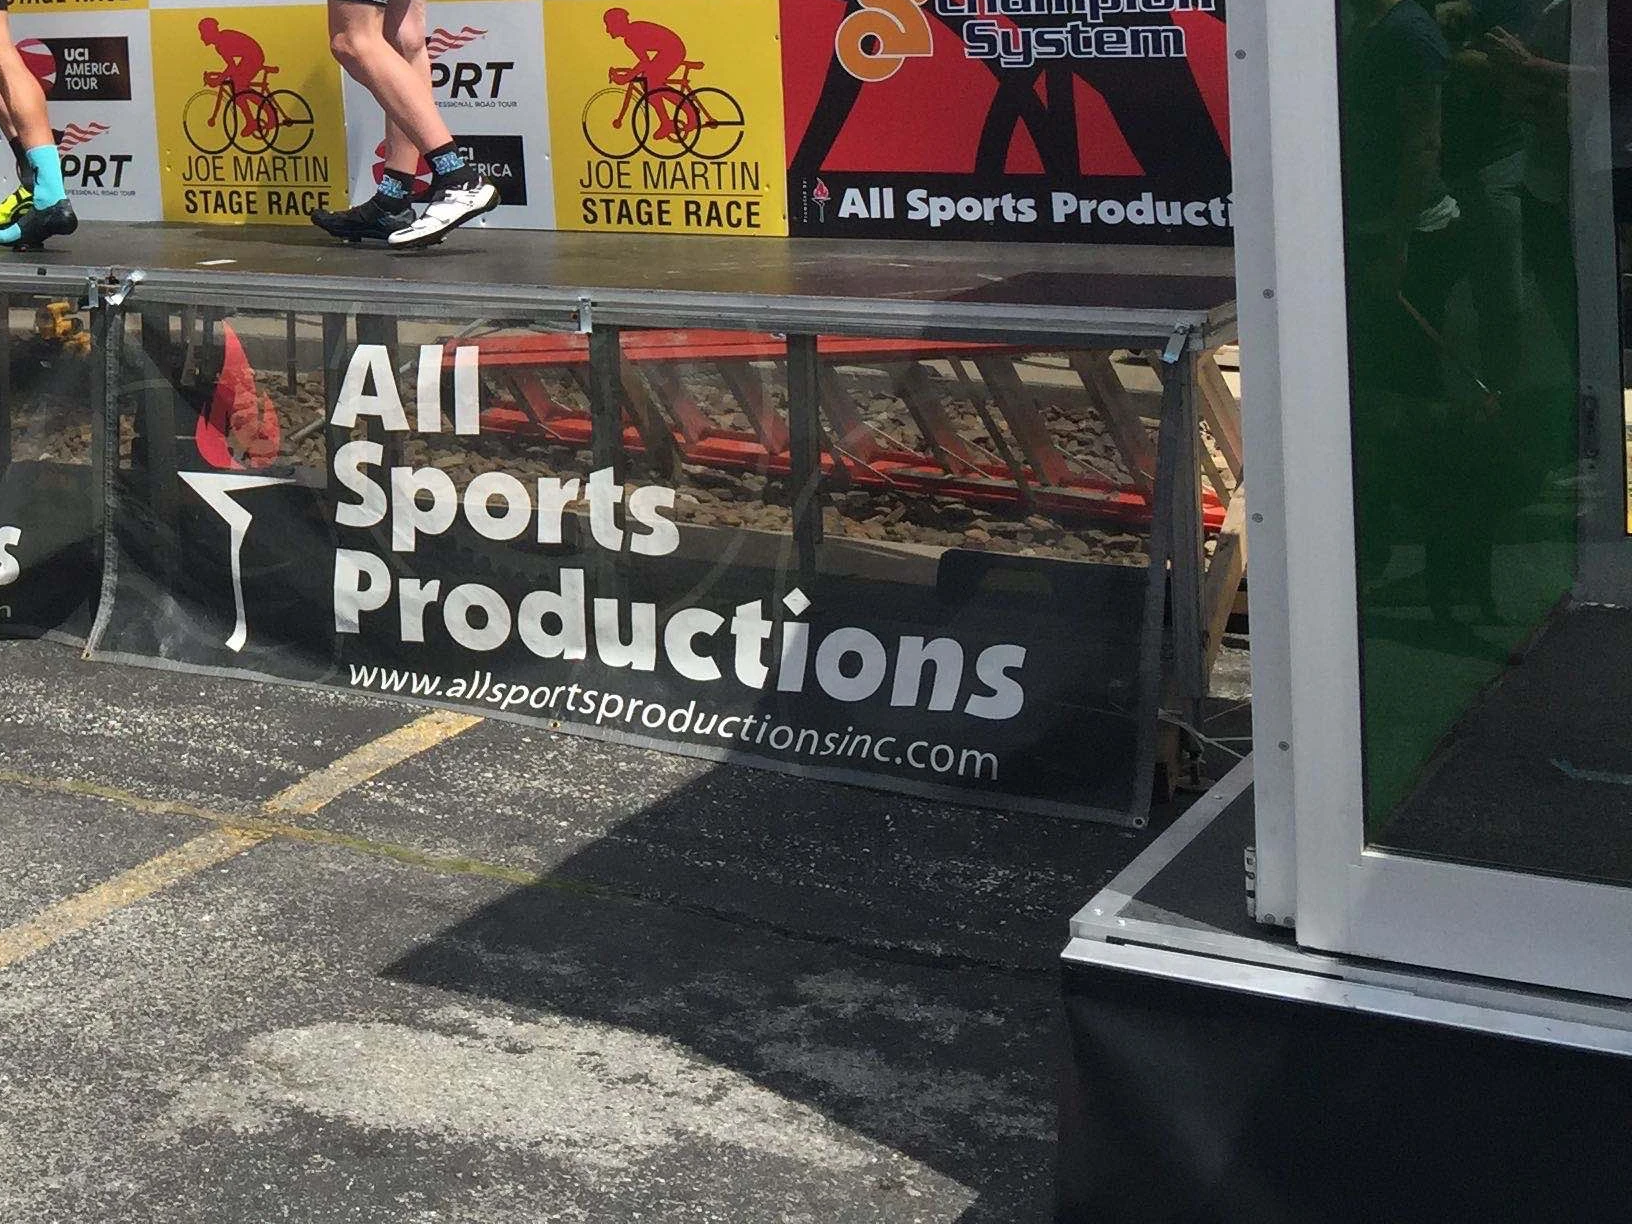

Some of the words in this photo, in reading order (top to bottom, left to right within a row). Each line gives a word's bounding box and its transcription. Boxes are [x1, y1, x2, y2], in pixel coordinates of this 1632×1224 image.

[64, 47, 89, 61] UCI
[964, 21, 1185, 68] System
[64, 62, 120, 76] AMERICA
[65, 76, 98, 90] TOUR
[183, 156, 226, 182] JOE
[233, 155, 329, 183] MARTIN
[579, 160, 632, 191] JOE
[643, 160, 760, 191] MARTIN
[185, 190, 258, 215] STAGE
[268, 191, 330, 216] RACE
[582, 198, 672, 226] STAGE
[684, 200, 762, 229] RACE
[838, 188, 894, 220] All
[908, 189, 1037, 226] Sports
[330, 344, 480, 435] All
[333, 440, 681, 556] Sports
[334, 548, 1027, 720] Productions
[349, 663, 999, 781] www.allsportsproductionsinc.com
